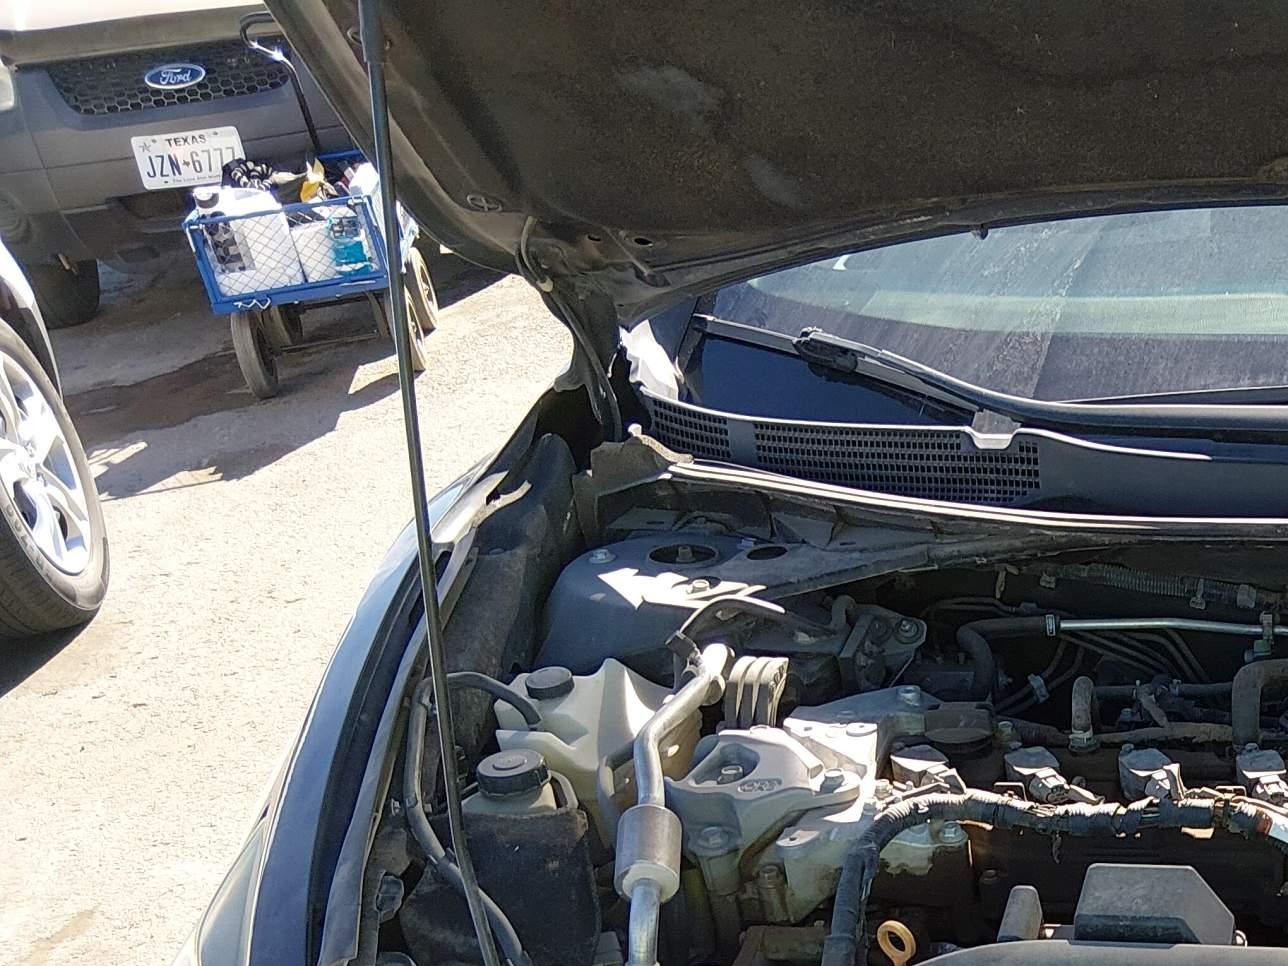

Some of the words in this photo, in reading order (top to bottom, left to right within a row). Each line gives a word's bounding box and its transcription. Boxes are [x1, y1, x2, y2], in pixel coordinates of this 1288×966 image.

[160, 68, 191, 85] Ford
[165, 134, 207, 148] TEXAS
[146, 153, 182, 178] JZN
